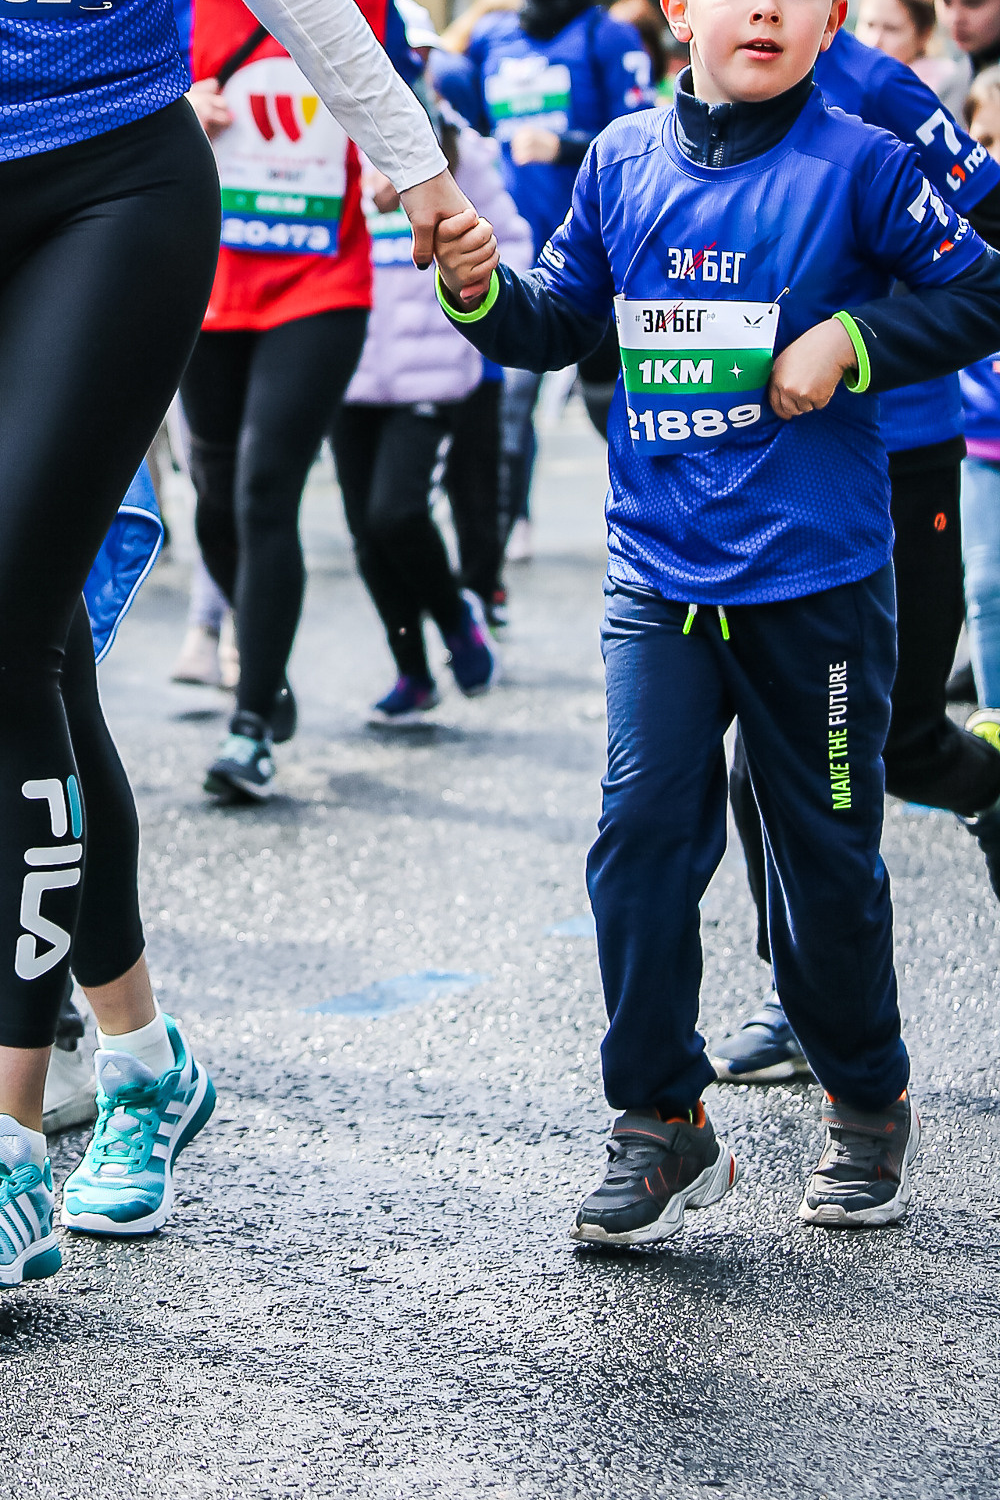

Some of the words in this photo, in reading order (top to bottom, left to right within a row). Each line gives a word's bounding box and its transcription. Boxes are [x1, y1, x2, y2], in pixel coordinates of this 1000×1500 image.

[916, 108, 962, 155] 7
[907, 176, 949, 228] 7
[627, 403, 761, 442] 21889
[828, 660, 848, 726] FUTURE
[828, 728, 848, 760] THE
[829, 762, 852, 810] MAKE
[14, 773, 83, 981] FILA
